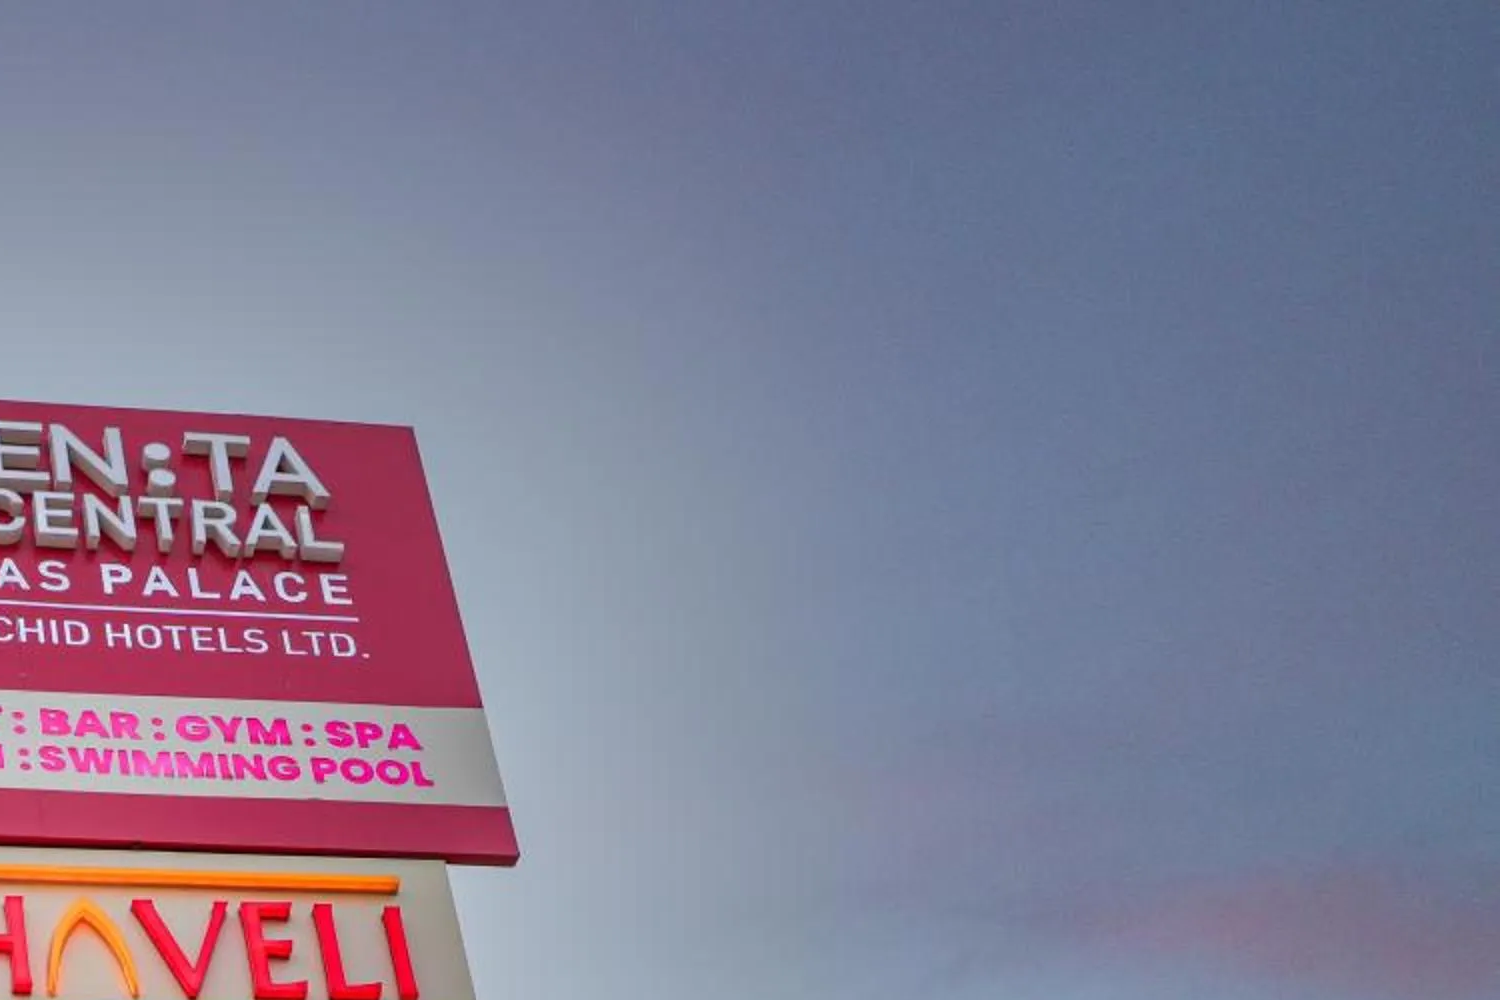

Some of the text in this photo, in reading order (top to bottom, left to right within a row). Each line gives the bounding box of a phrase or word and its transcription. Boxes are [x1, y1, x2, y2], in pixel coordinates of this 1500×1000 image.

[102, 563, 353, 605] PALACE
[105, 623, 269, 654] HOTELS
[281, 629, 370, 658] LTD.
[39, 708, 142, 741] BAR
[176, 715, 293, 747] GYM
[325, 720, 423, 751] SPA
[37, 745, 301, 781] SWIMMING
[310, 756, 435, 788] POOL
